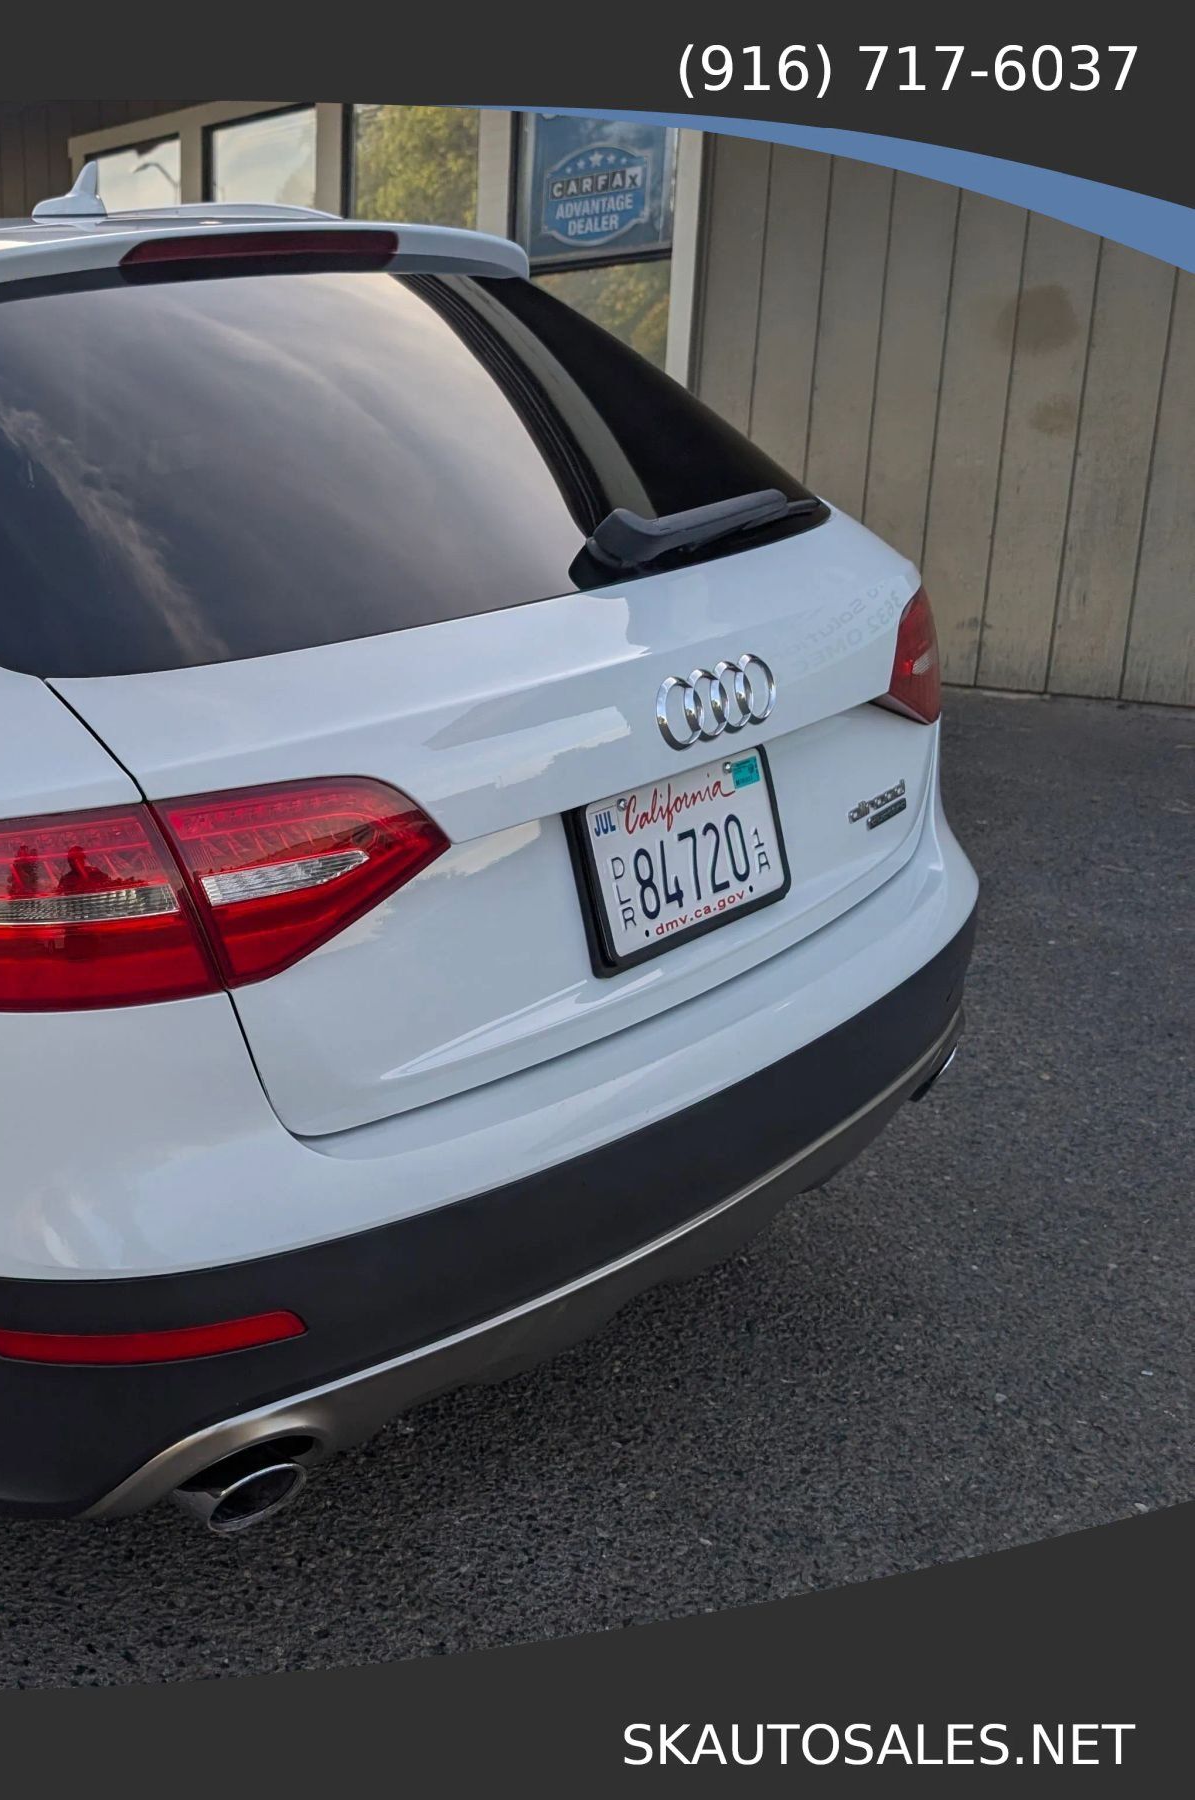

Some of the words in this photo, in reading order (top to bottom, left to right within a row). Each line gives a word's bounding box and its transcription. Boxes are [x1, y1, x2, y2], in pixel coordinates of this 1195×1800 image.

[552, 172, 640, 198] CARFAX
[556, 193, 633, 220] ADVANTAGE
[568, 213, 619, 237] DEALER
[624, 773, 736, 835] California
[594, 810, 616, 837] JUL
[634, 814, 751, 920] 84720
[656, 889, 745, 936] dmv.ca.gov
